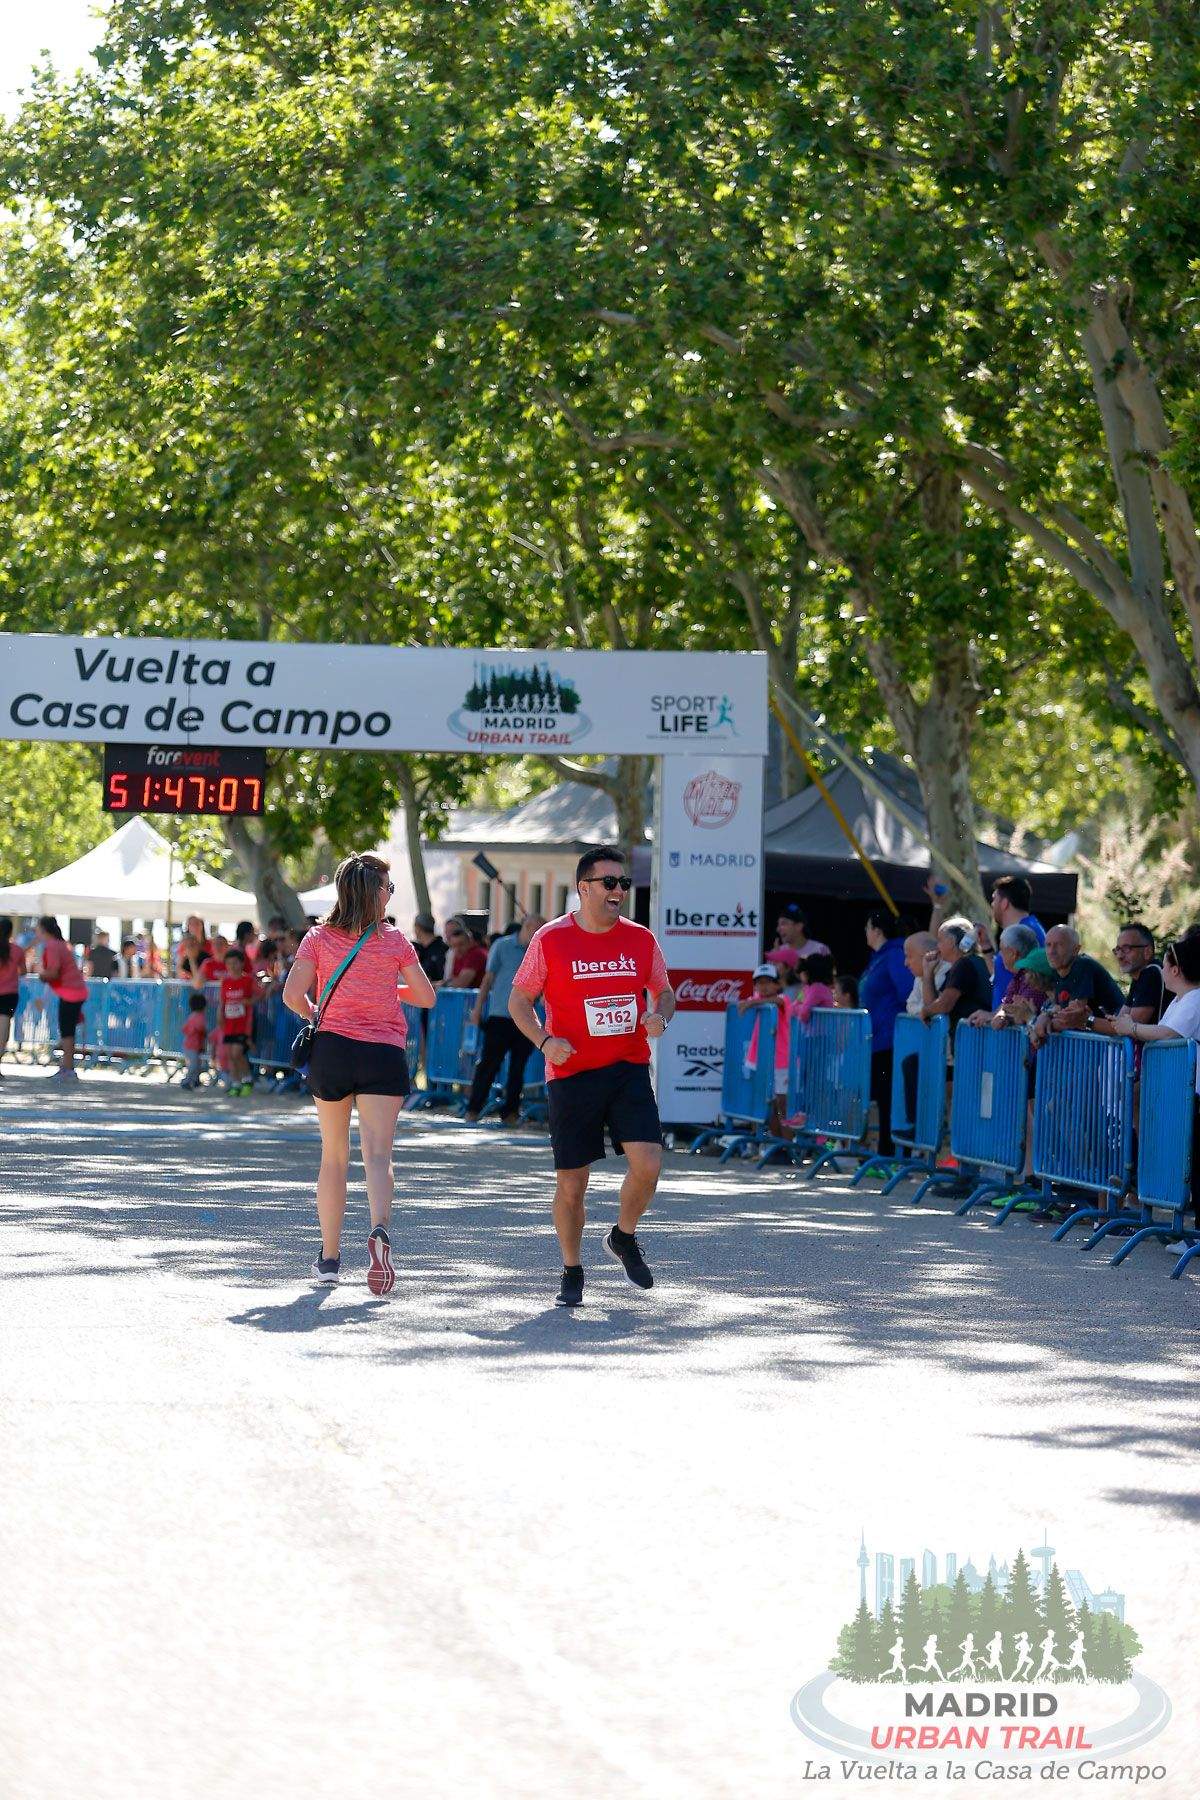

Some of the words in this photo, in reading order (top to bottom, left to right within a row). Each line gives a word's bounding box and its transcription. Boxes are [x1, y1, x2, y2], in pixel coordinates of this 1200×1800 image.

[74, 647, 232, 686] Vuelta
[246, 658, 276, 688] a
[651, 695, 717, 712] SPORT
[9, 693, 130, 731] Casa
[144, 697, 205, 732] de
[220, 700, 392, 745] Campo
[484, 717, 556, 730] MADRID
[661, 715, 708, 733] LIFE
[466, 731, 523, 744] URBAN
[528, 732, 572, 745] TRAIL
[147, 745, 222, 768] forevent
[690, 853, 757, 868] MADRID
[665, 907, 758, 928] Iberext
[571, 958, 637, 974] Iberext
[595, 1010, 631, 1026] 2162
[676, 1044, 726, 1058] Reebo
